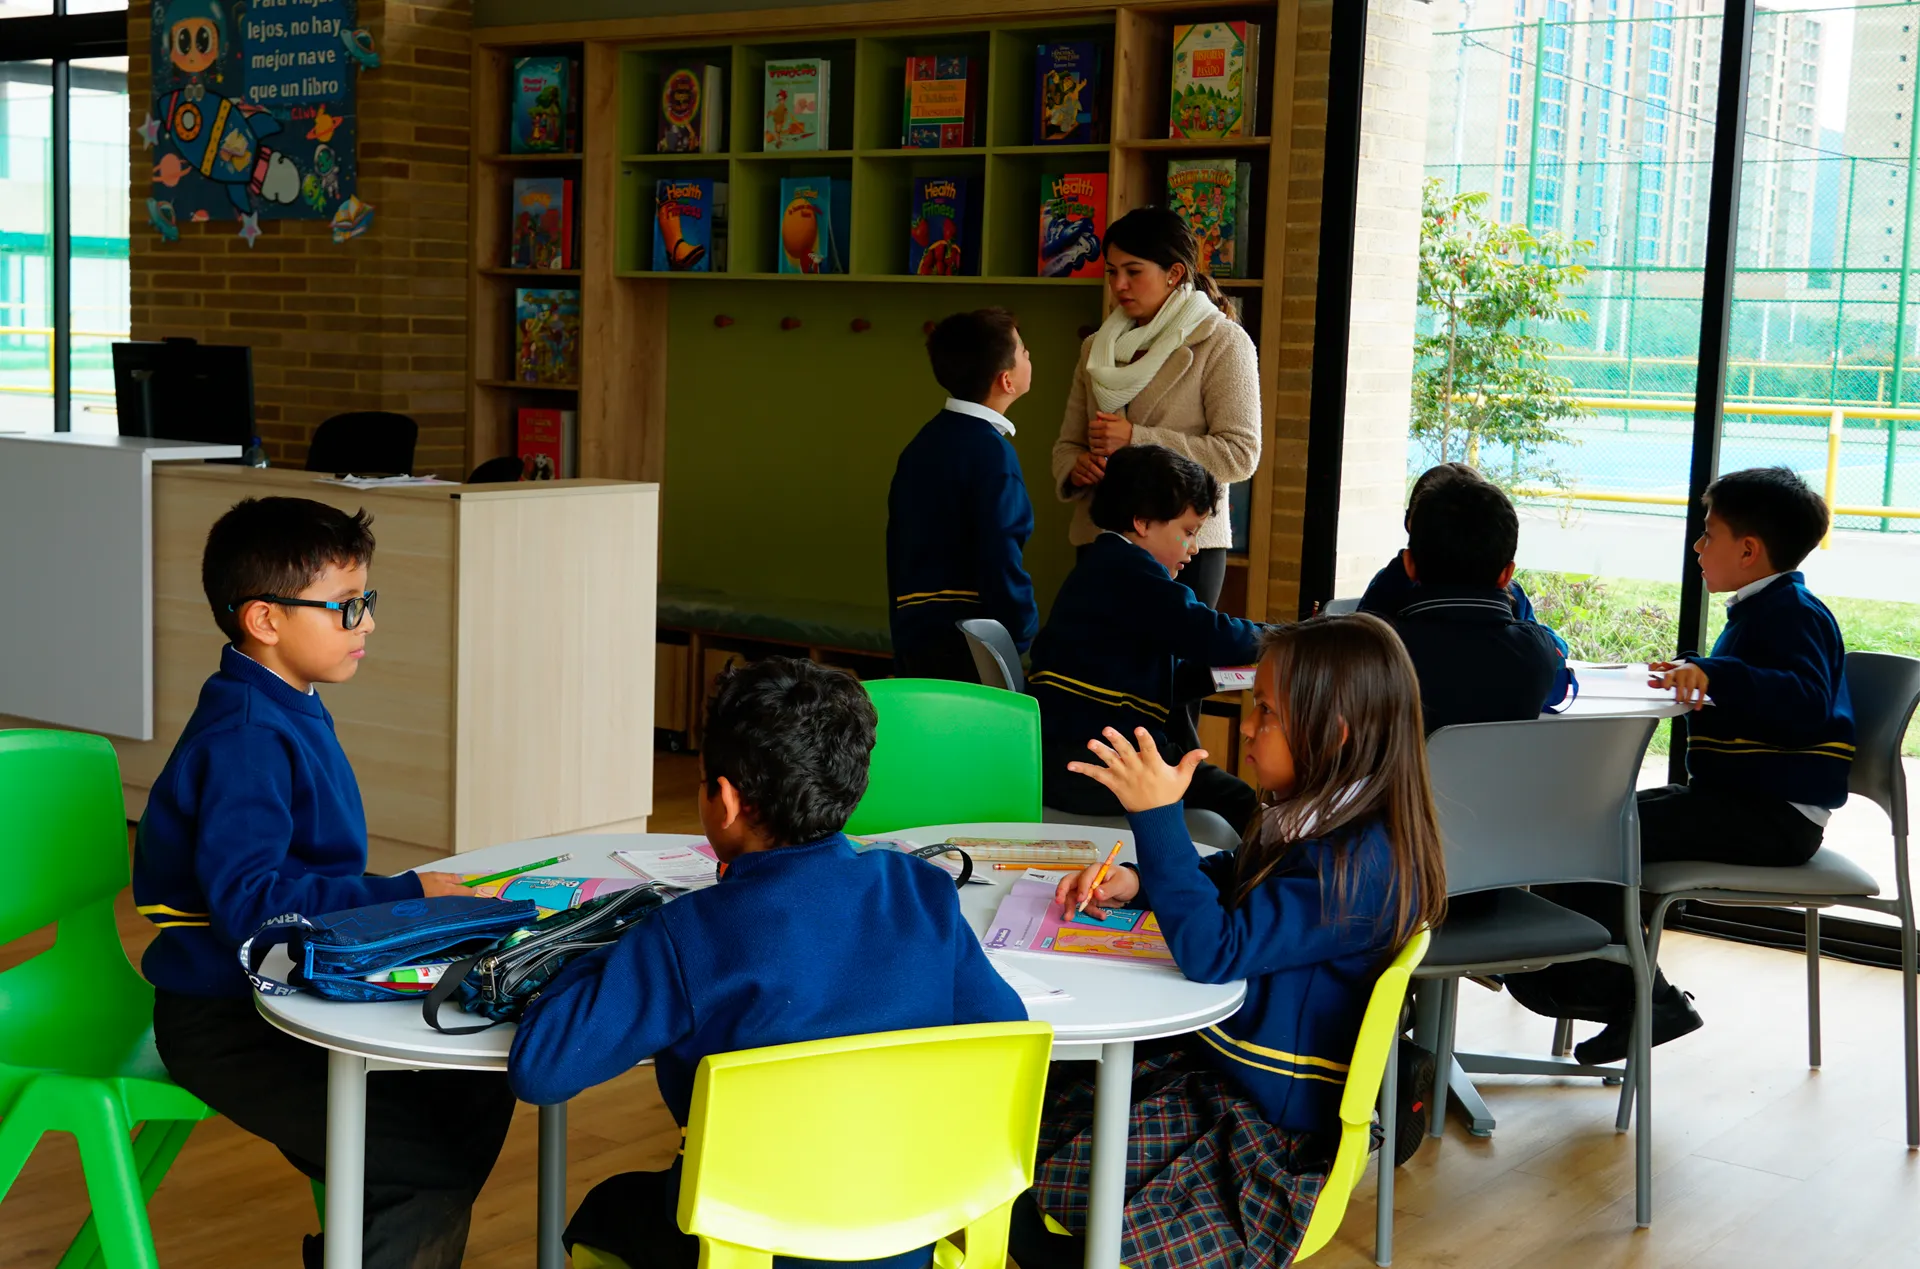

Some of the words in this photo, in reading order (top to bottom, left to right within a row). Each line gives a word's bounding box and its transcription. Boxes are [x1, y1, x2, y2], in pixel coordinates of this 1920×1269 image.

[248, 20, 288, 43] lejos,
[291, 22, 309, 36] no
[312, 16, 341, 38] hay
[252, 49, 294, 71] mejor
[298, 50, 336, 65] nave
[250, 84, 277, 103] que
[281, 83, 300, 97] un
[302, 77, 338, 96] libro
[667, 184, 702, 200] Health
[925, 181, 956, 200] Health
[1052, 178, 1093, 198] Health
[922, 202, 955, 218] Fitness
[1051, 201, 1094, 218] Fitness
